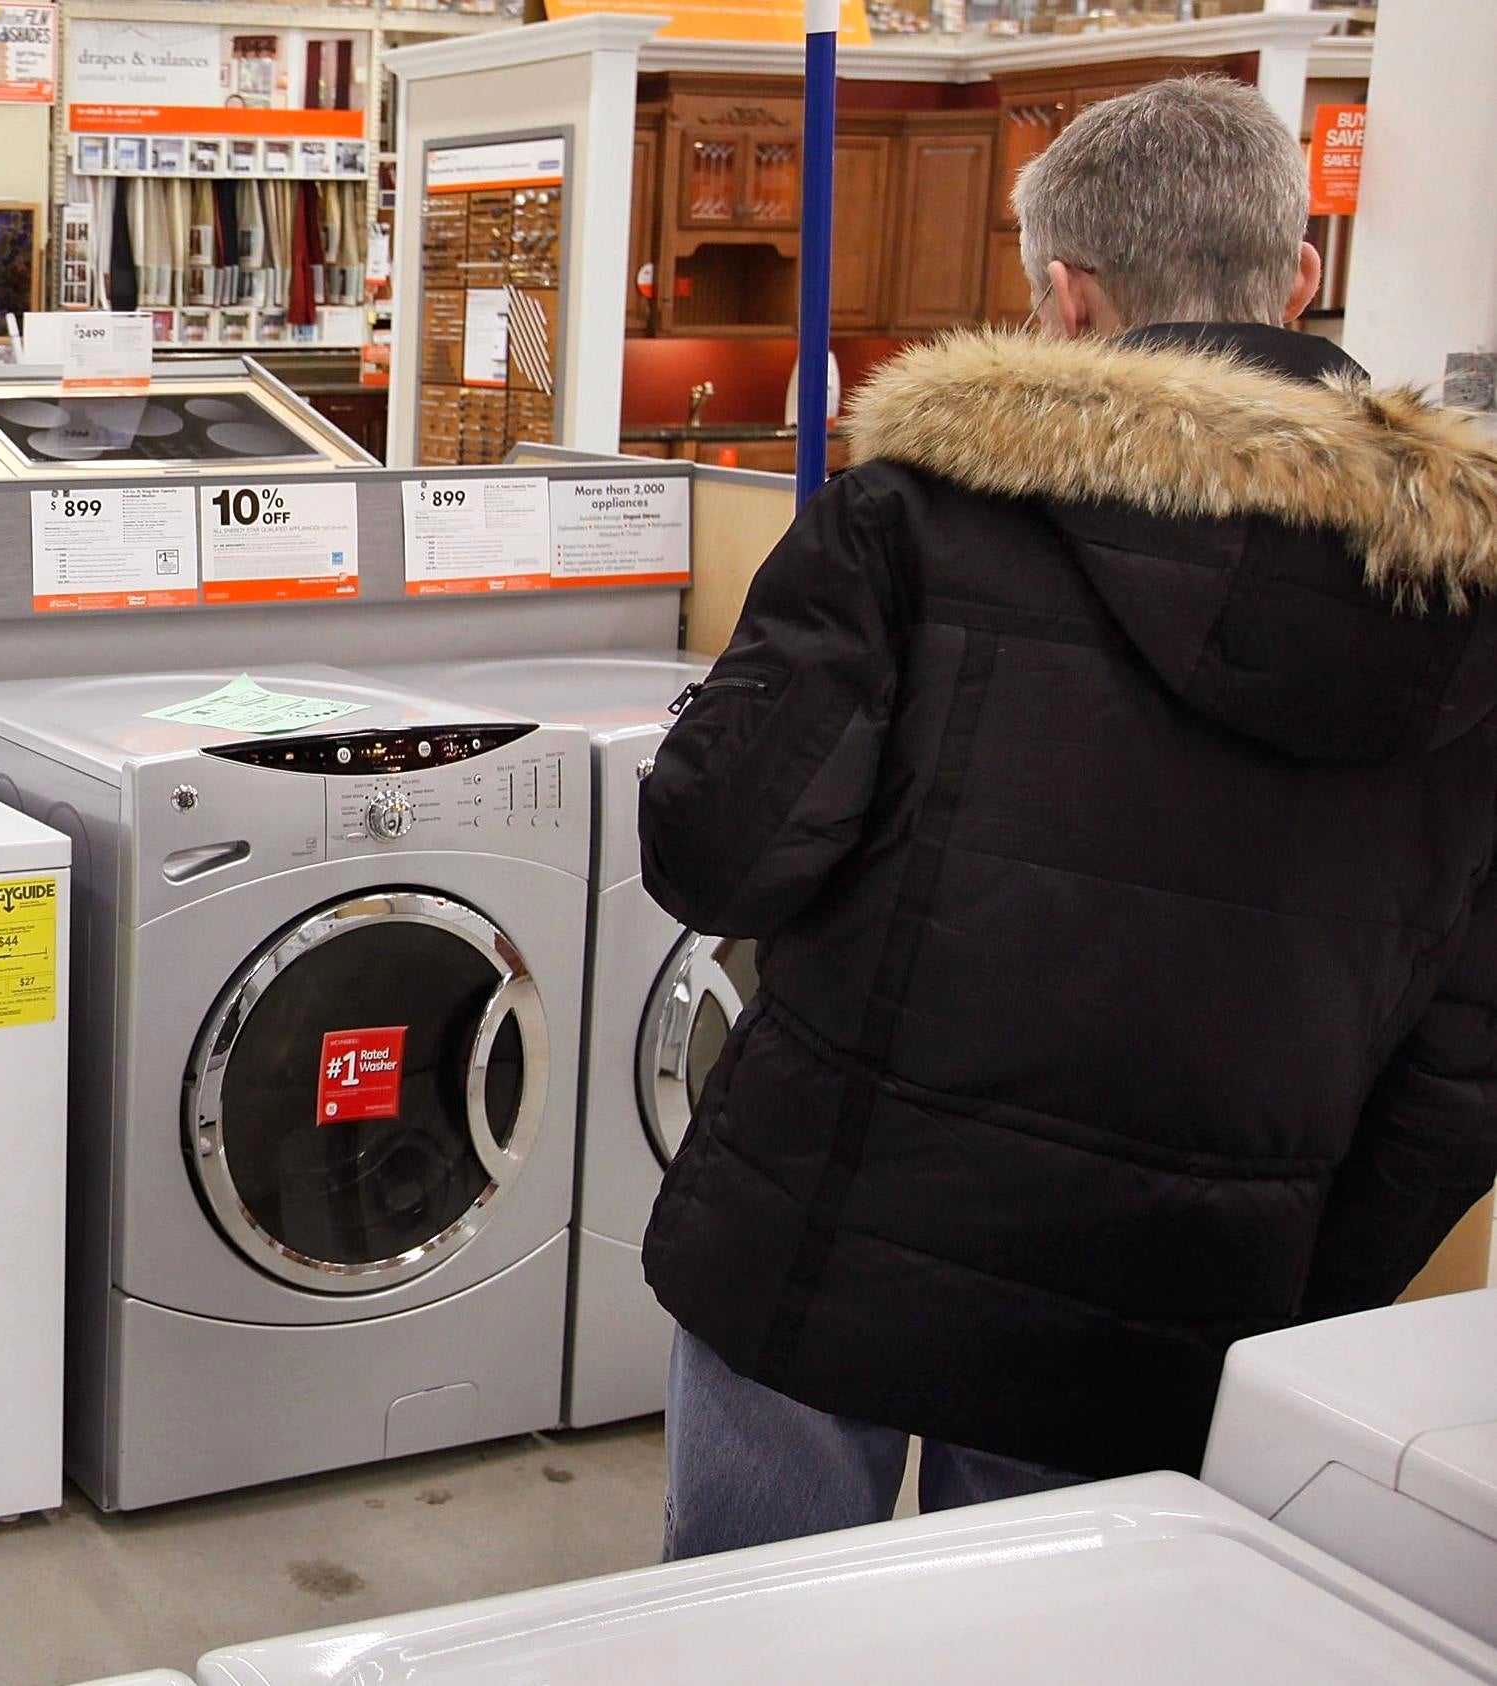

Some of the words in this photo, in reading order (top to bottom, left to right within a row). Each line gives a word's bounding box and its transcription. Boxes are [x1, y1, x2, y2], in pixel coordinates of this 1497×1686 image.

[78, 49, 126, 69] drapes
[152, 52, 209, 67] valances
[575, 486, 602, 496] More
[606, 485, 630, 495] than
[634, 484, 665, 495] 2,000
[420, 492, 425, 500] $
[432, 490, 466, 507] 899
[592, 497, 648, 511] appliances
[51, 501, 56, 510] $
[64, 500, 102, 517] 899
[262, 512, 291, 524] OFF
[19, 977, 35, 986] $27
[326, 1050, 359, 1086] #1
[361, 1048, 389, 1060] Rated
[360, 1061, 398, 1072] Washer
